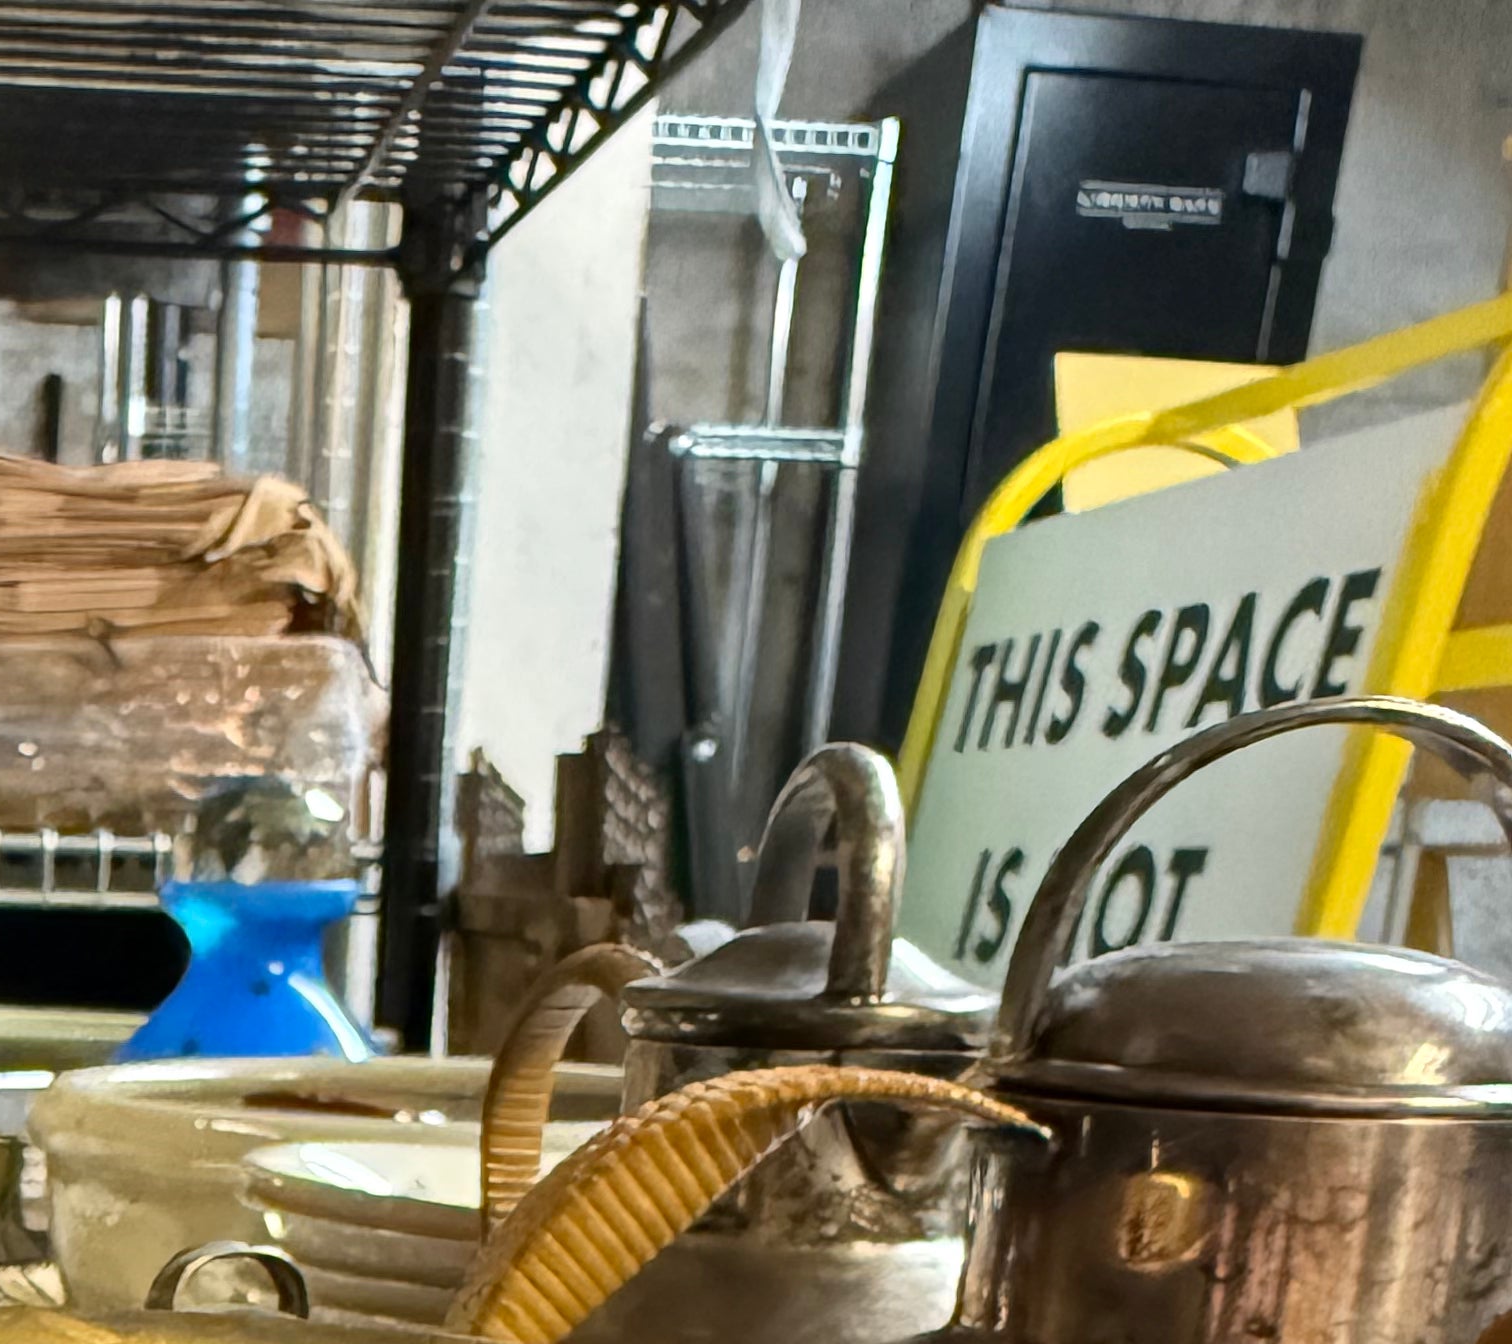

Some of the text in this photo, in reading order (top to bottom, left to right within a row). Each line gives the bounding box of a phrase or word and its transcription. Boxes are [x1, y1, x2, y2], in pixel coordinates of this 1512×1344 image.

[953, 568, 1382, 753] THIS SPACE
[953, 845, 1209, 966] IS OT
